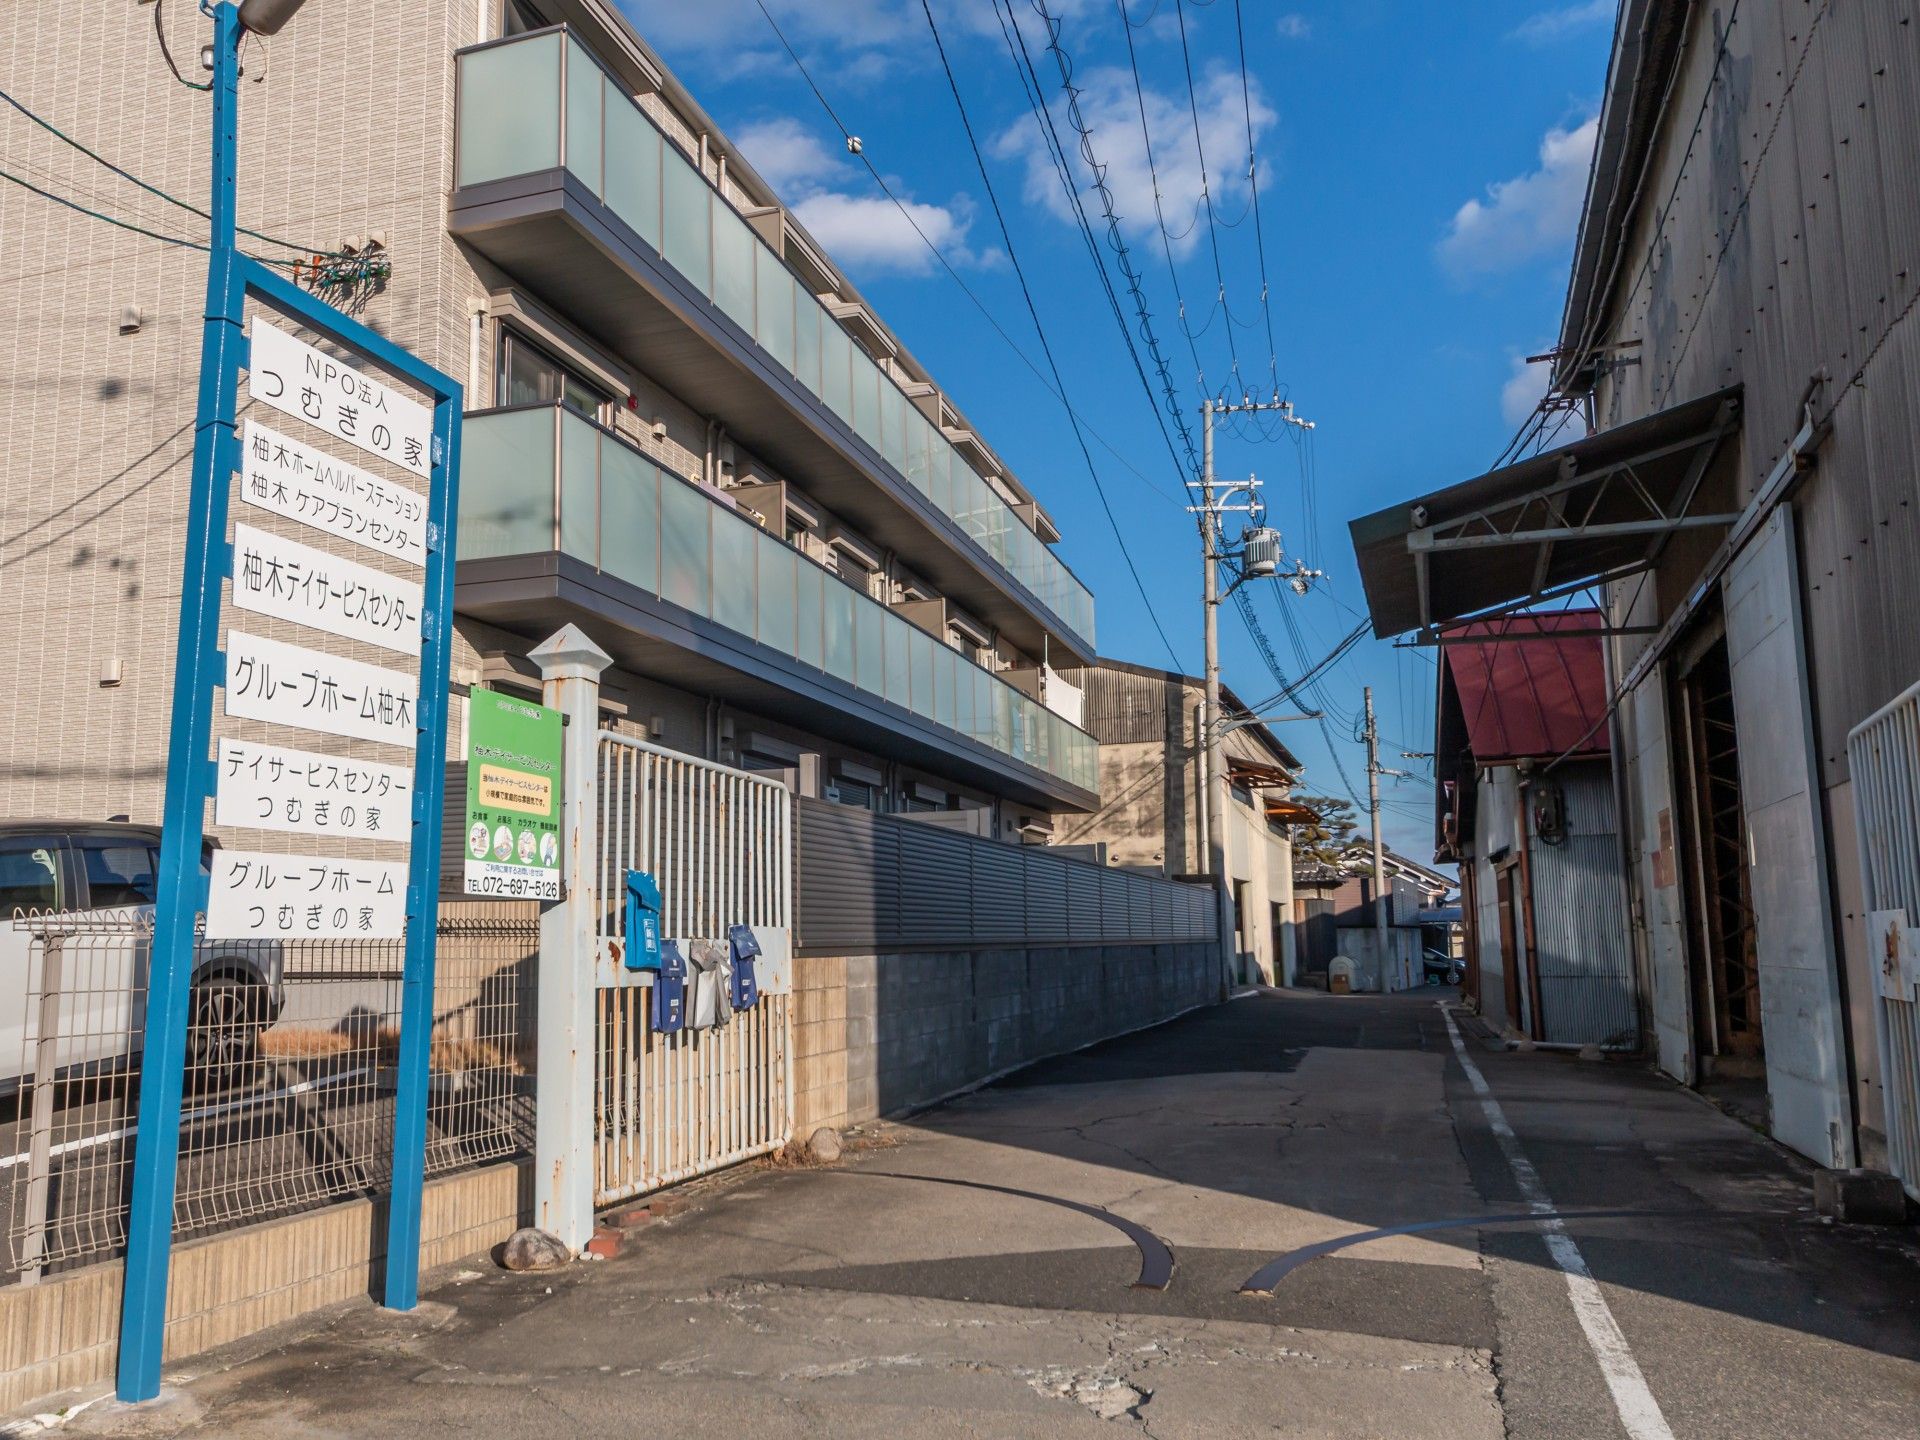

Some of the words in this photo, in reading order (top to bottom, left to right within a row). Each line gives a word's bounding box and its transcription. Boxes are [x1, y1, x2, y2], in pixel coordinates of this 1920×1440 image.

[306, 353, 388, 414] NPO法人
[262, 370, 423, 468] つむぎの家
[243, 546, 416, 632] 柚木デイサービスセンター
[235, 655, 411, 729] グループホーム柚木
[228, 750, 406, 797] デイサービスセンター
[257, 796, 381, 831] つむぎの家
[517, 818, 537, 829] カラオケ
[229, 861, 394, 894] グループホーム
[482, 876, 558, 898] 072-697-5126
[249, 903, 374, 931] つむぎの家
